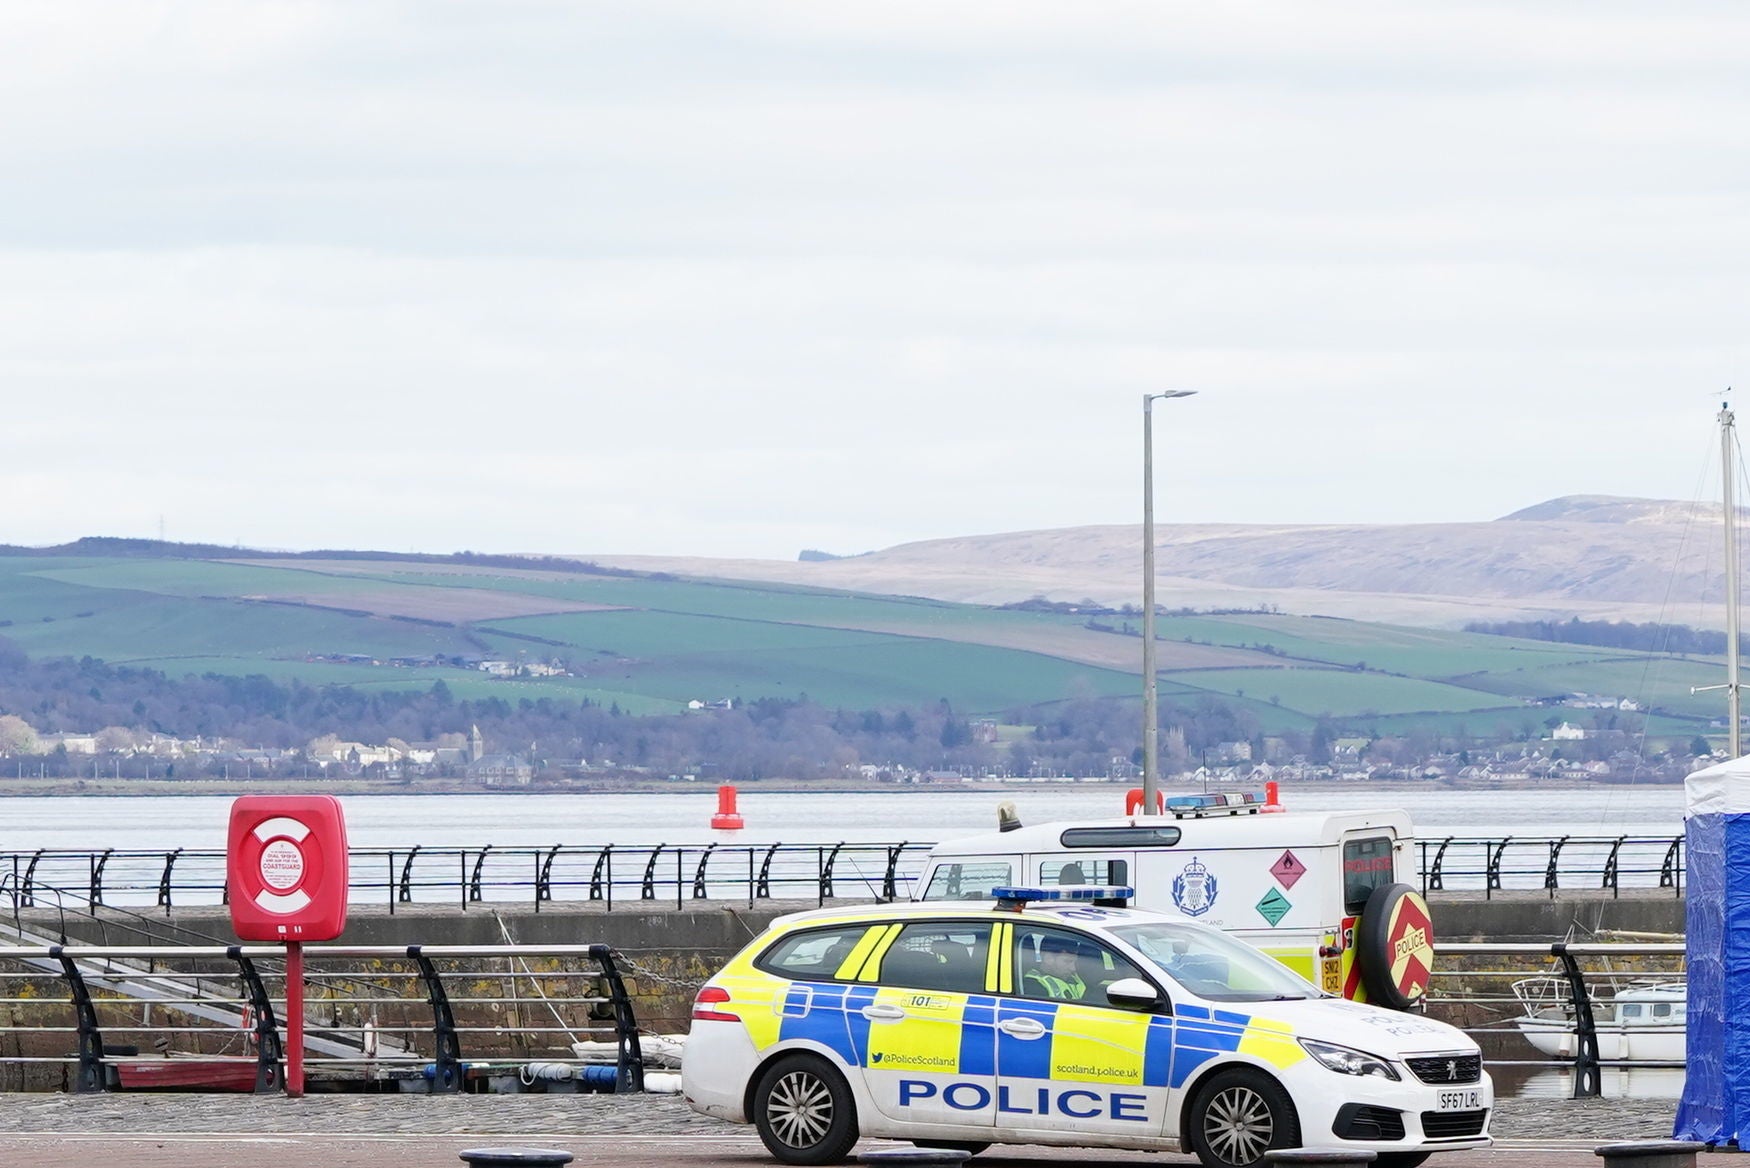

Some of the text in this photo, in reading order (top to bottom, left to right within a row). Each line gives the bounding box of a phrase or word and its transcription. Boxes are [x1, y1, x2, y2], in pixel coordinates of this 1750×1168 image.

[1345, 857, 1392, 873] POLICE
[1396, 931, 1425, 956] POLICE
[1324, 959, 1339, 974] SN12
[1325, 975, 1339, 989] CHZ
[911, 995, 931, 1007] 101
[884, 1053, 956, 1067] @PoliceScotland
[1056, 1064, 1139, 1079] scotland.police.uk
[899, 1079, 1149, 1122] POLICE
[1441, 1092, 1480, 1109] SF67 LRL
